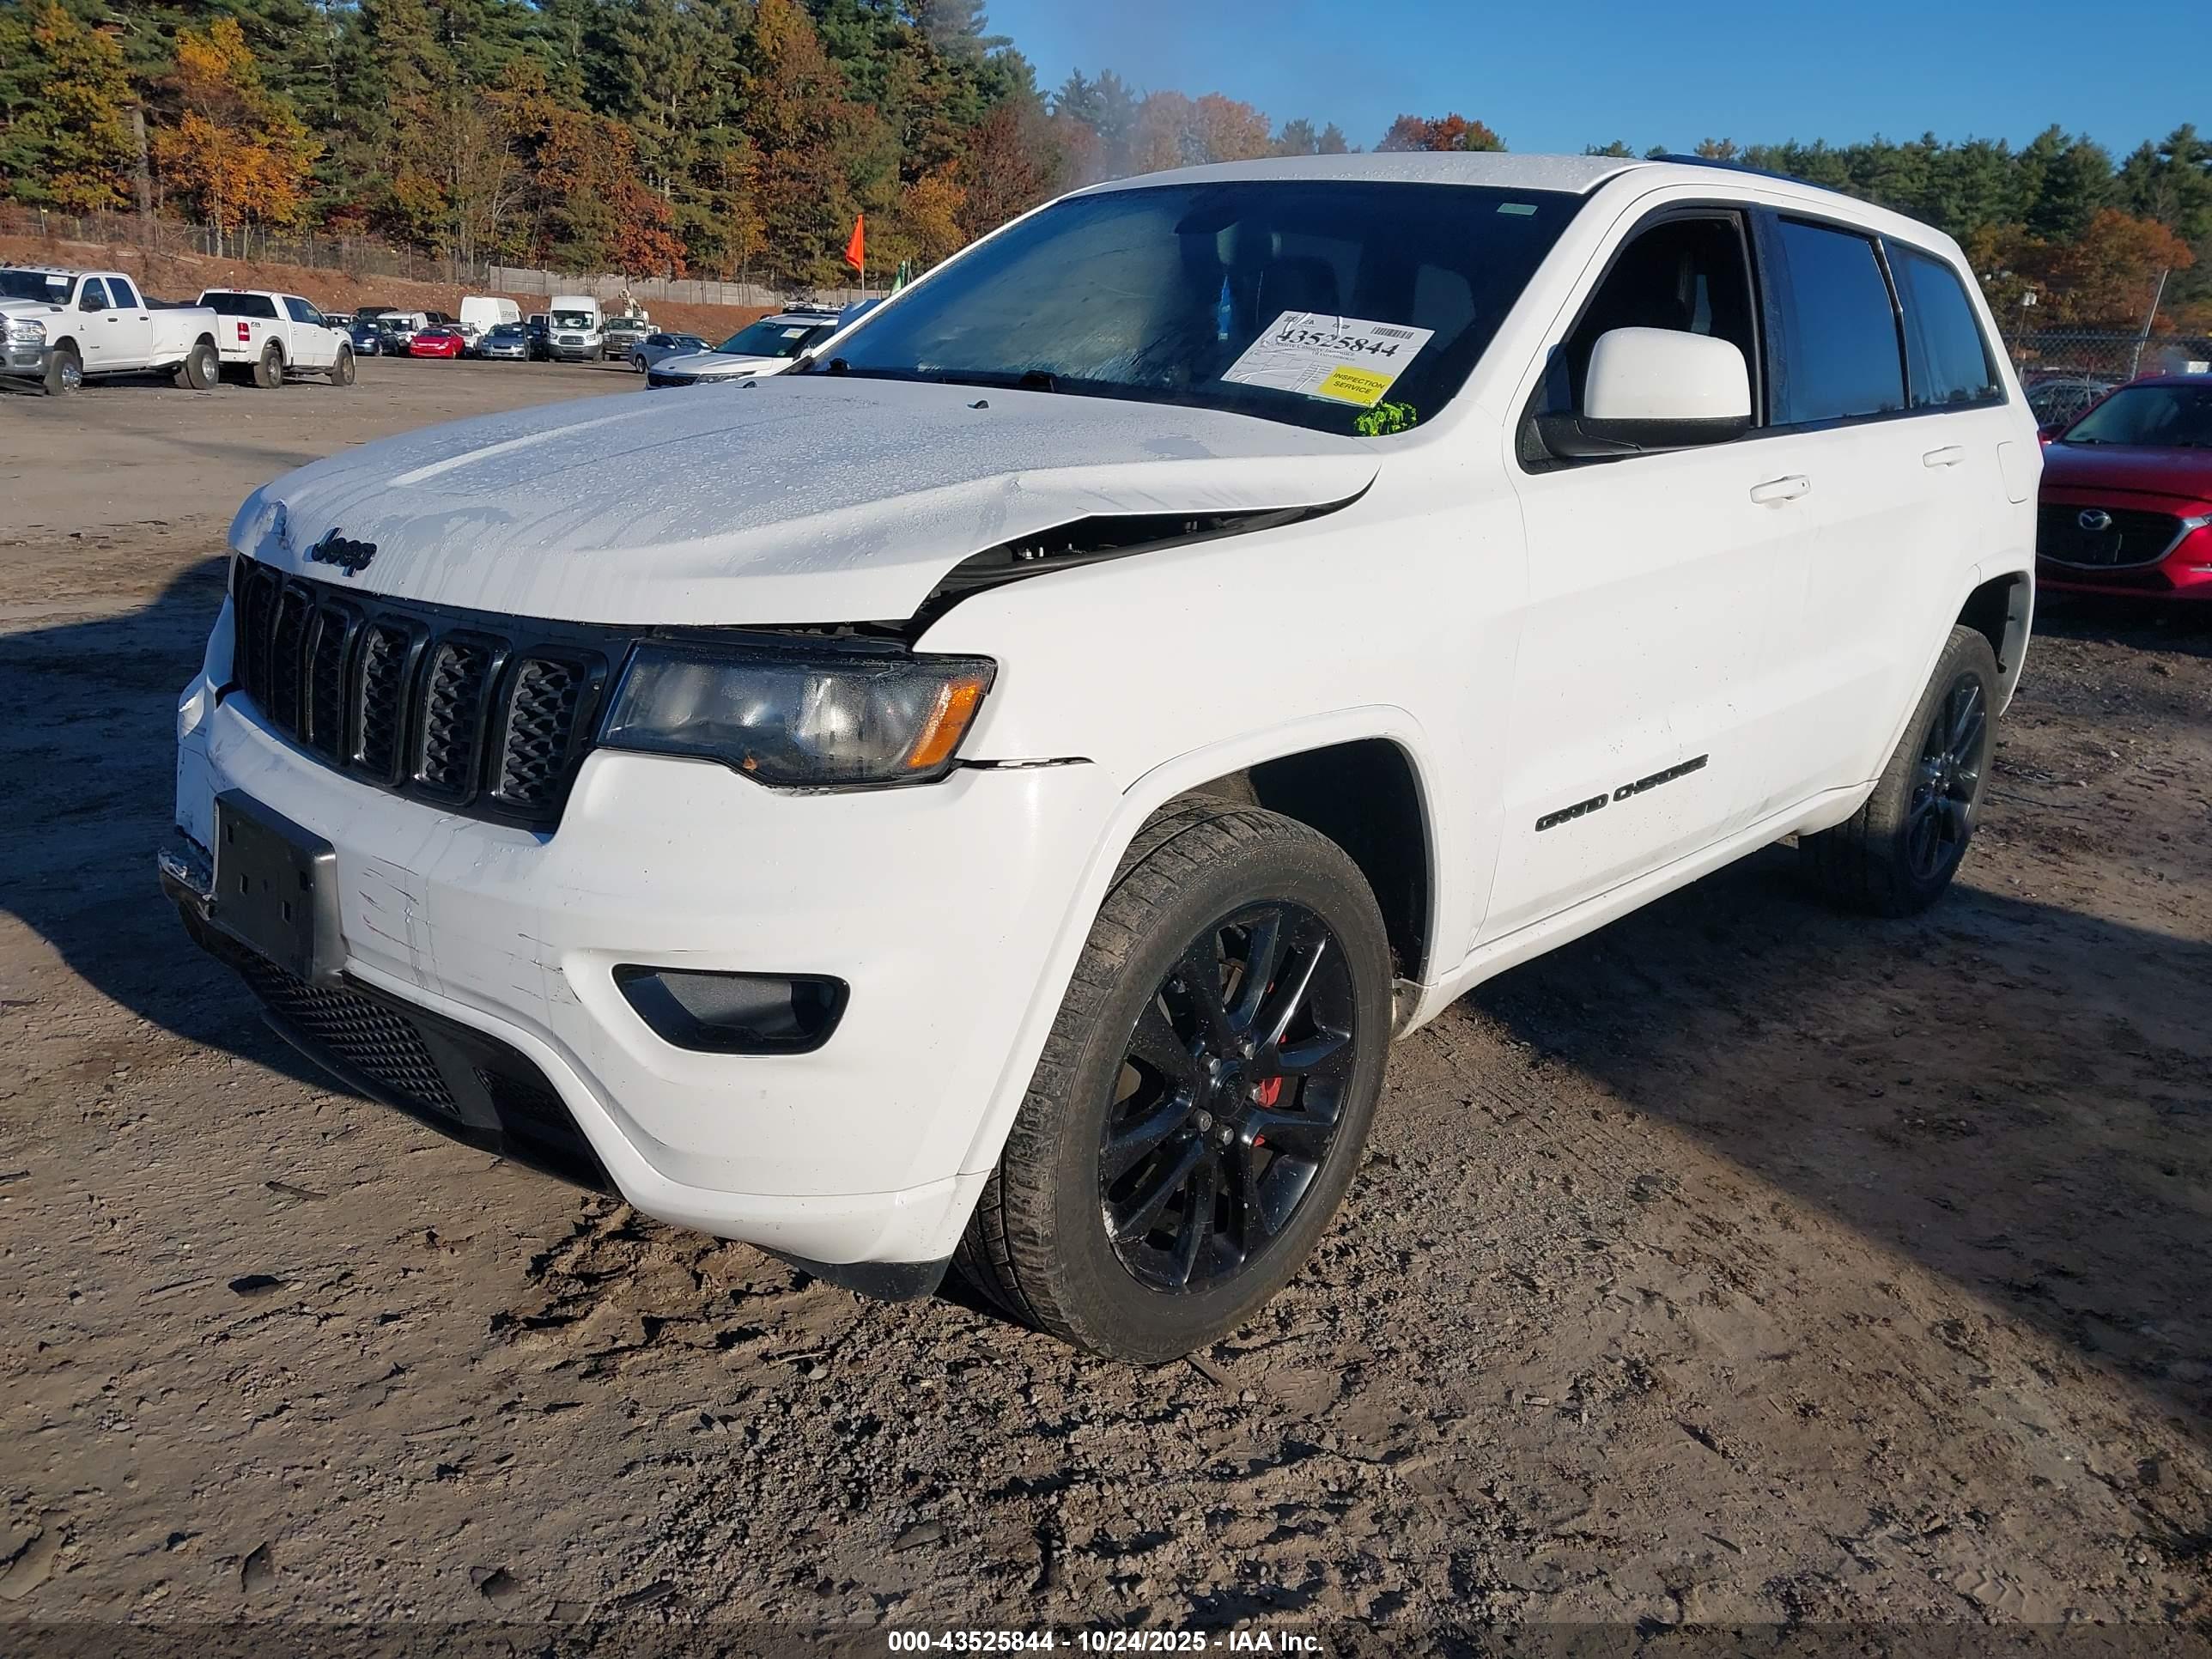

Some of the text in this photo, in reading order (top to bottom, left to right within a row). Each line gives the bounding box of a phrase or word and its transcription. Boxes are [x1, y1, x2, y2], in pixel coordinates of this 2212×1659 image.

[1276, 328, 1401, 357] 43525844
[1333, 372, 1385, 390] INSPECTION
[1333, 380, 1373, 395] SERVICE
[310, 527, 377, 577] Jeep
[1535, 793, 1608, 831] GRAND
